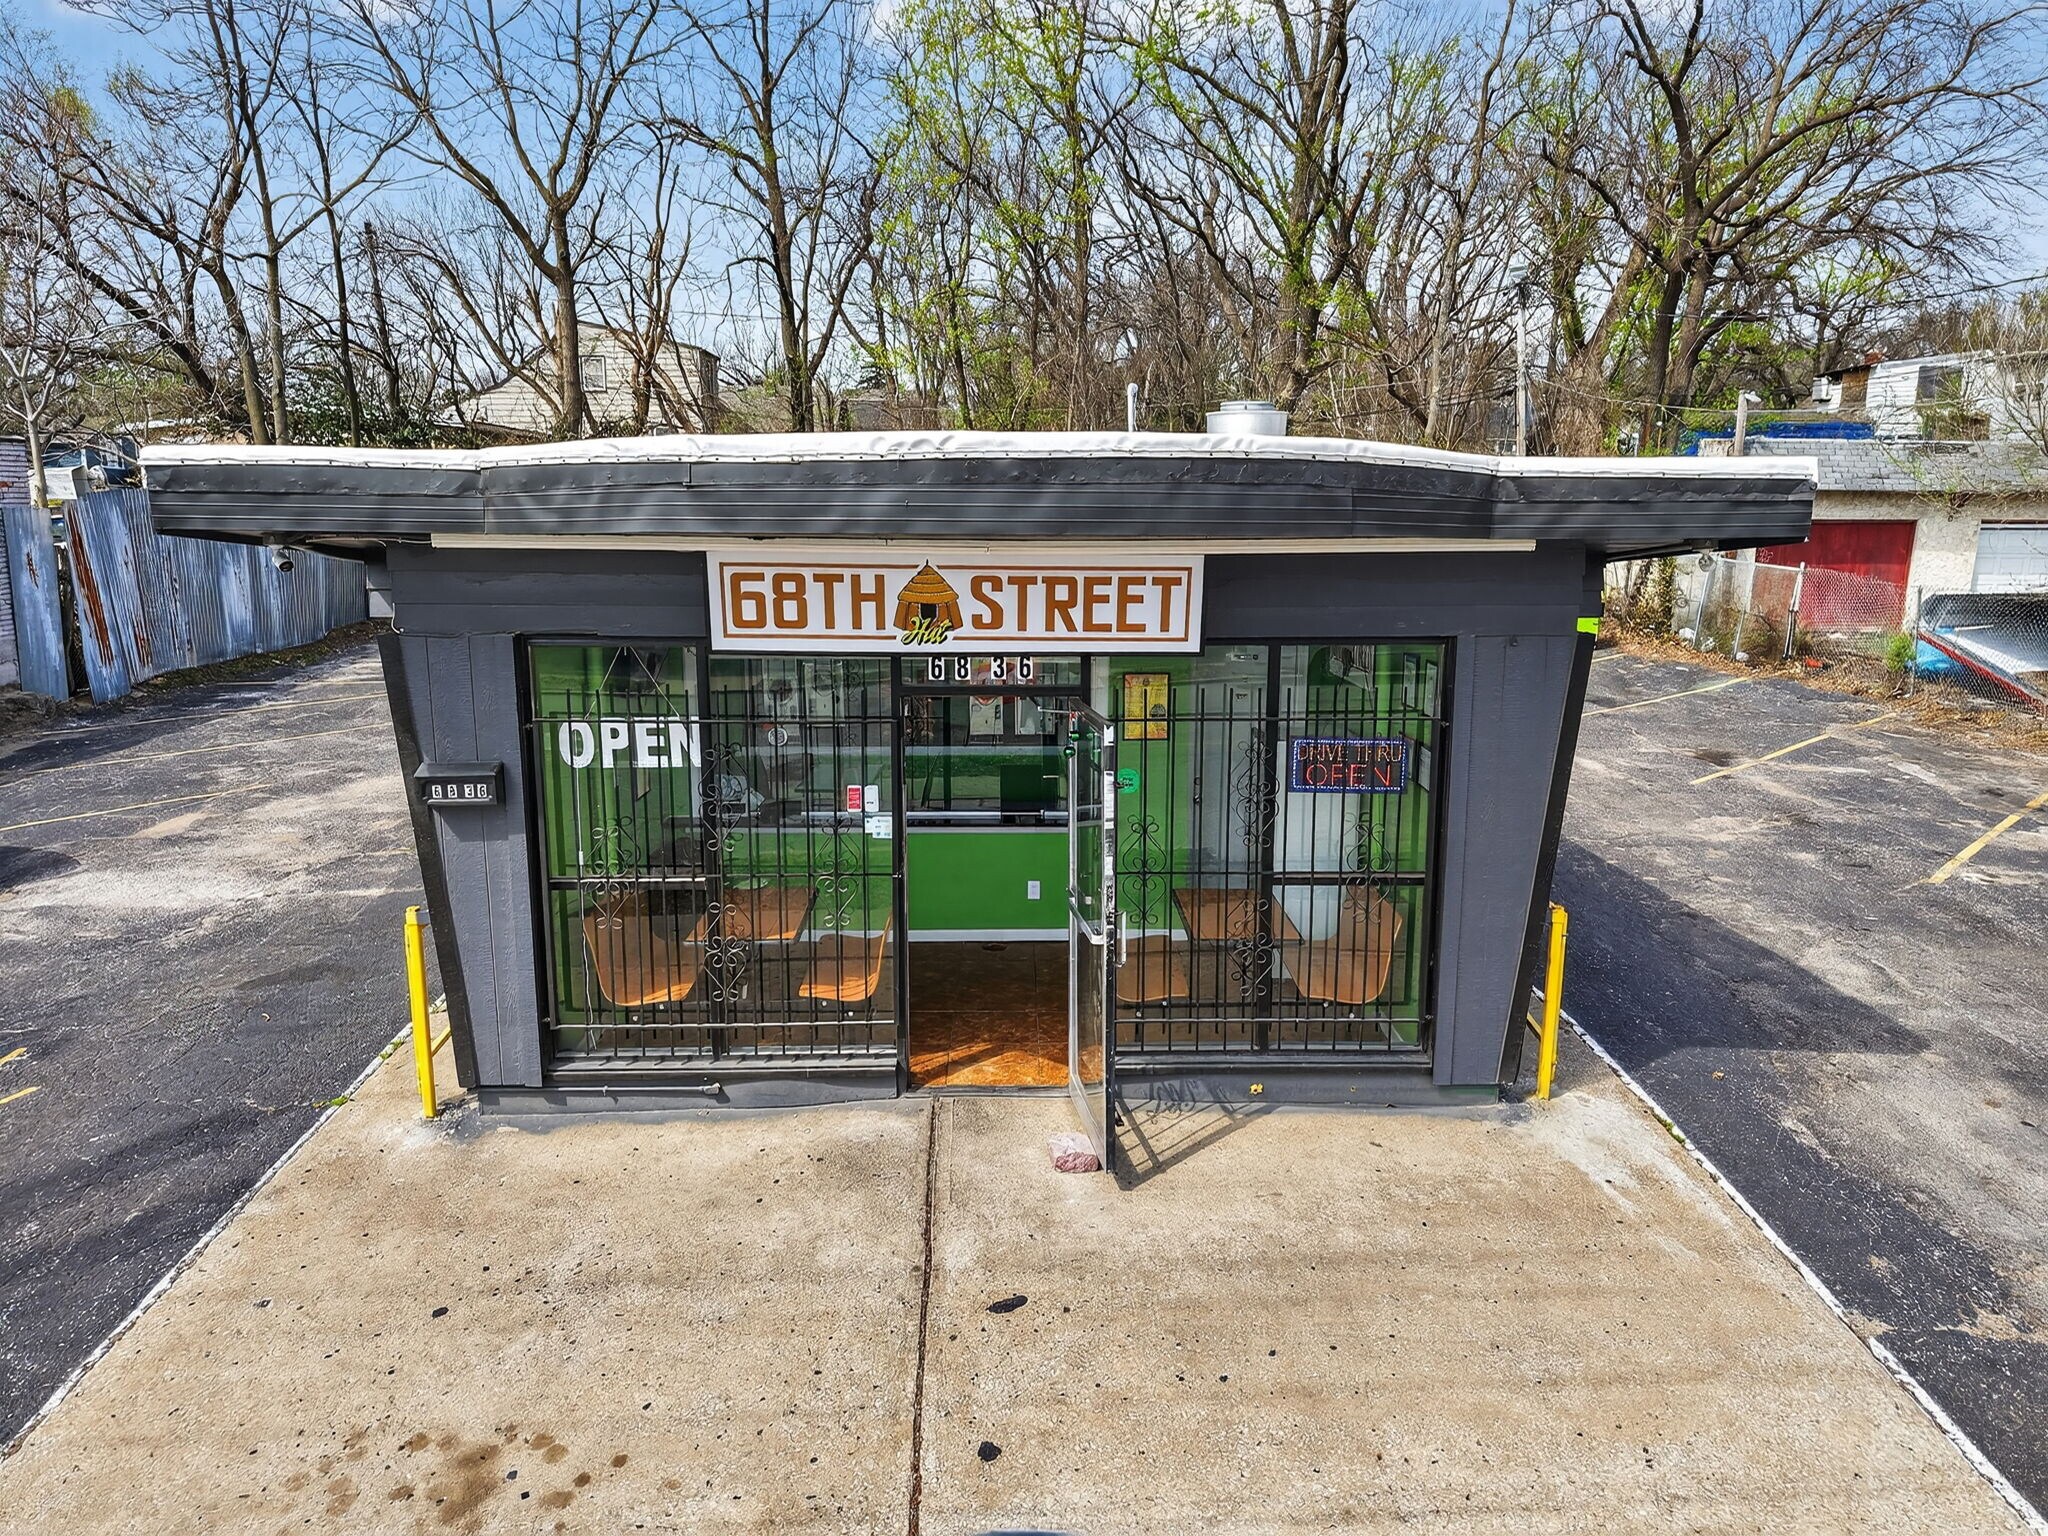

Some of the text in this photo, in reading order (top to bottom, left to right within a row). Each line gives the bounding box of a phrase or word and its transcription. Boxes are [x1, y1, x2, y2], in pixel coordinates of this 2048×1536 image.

[729, 571, 1183, 633] 68TH STREET
[901, 617, 952, 645] Hut
[930, 656, 1032, 679] 6836
[558, 717, 702, 769] OPEN
[1297, 744, 1348, 761] DRIVE
